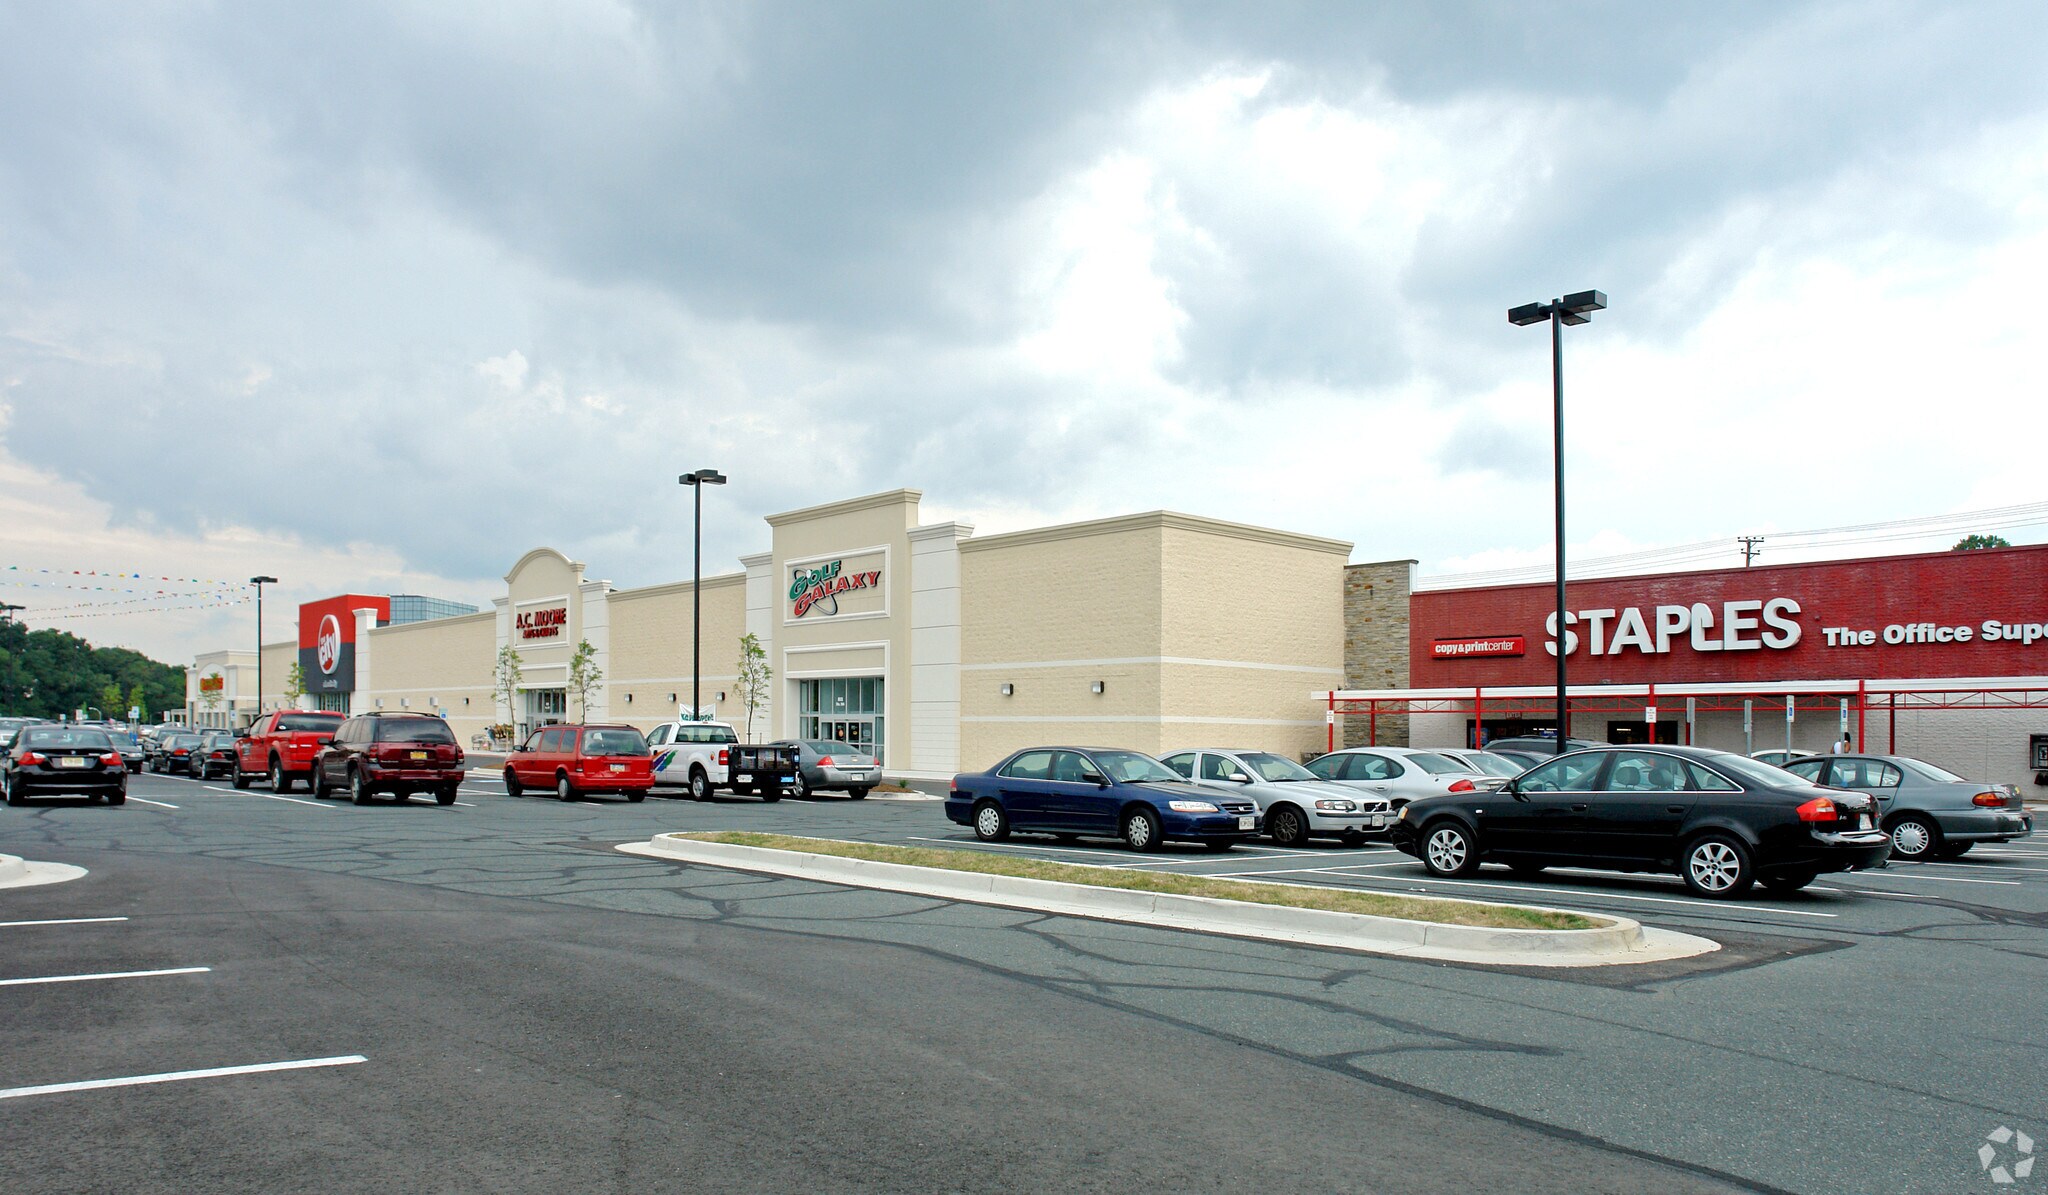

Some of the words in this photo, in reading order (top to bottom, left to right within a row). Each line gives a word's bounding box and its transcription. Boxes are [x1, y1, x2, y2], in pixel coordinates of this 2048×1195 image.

[789, 560, 841, 600] GOLF
[794, 571, 881, 617] GALAXY
[516, 612, 533, 629] A.C.
[534, 608, 566, 626] MOORE
[1545, 598, 1802, 657] STAPLES
[1822, 627, 1877, 646] The
[1883, 623, 1973, 645] Office
[320, 633, 335, 665] city
